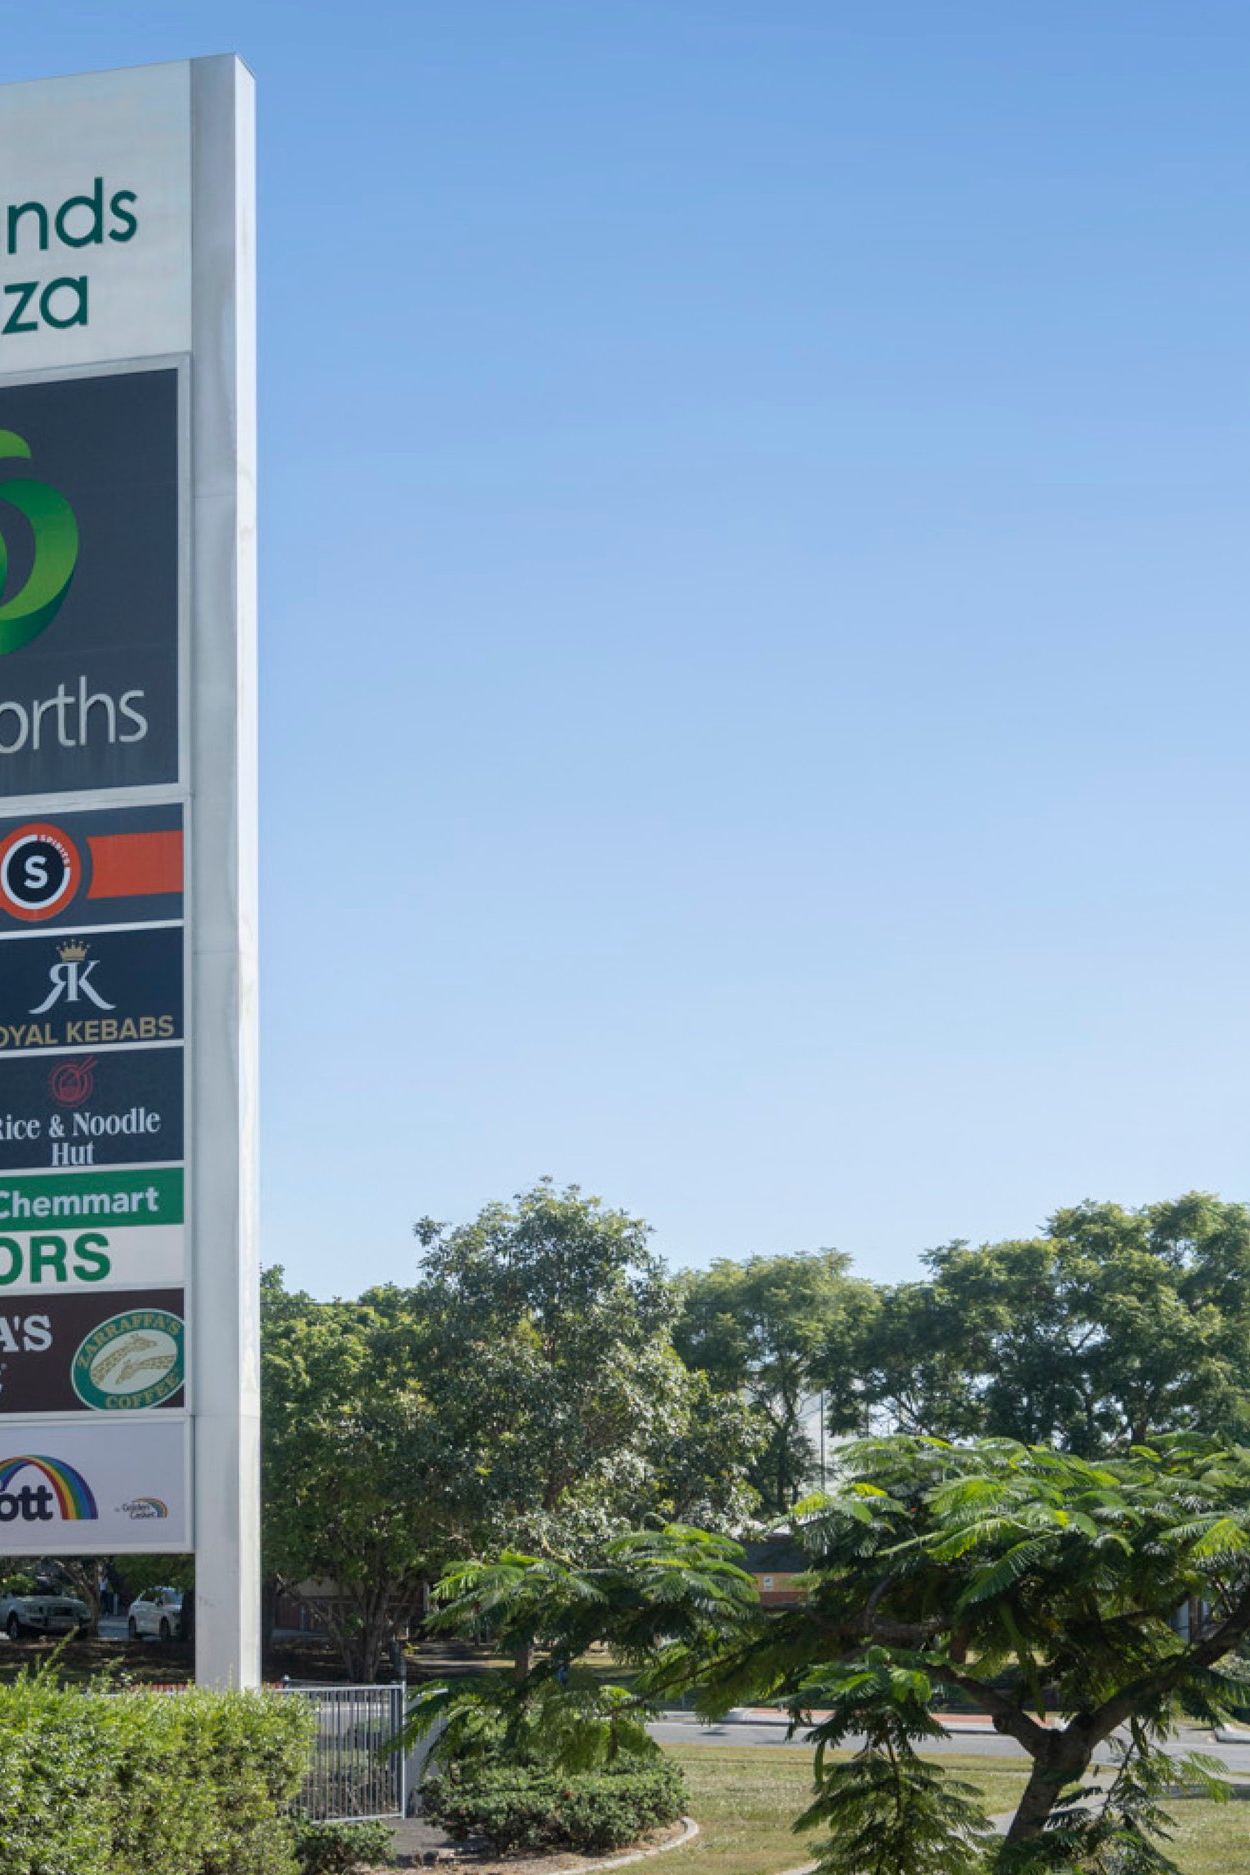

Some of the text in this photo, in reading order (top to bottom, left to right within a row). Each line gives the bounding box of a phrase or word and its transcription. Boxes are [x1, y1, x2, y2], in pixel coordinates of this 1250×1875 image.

[66, 1015, 174, 1043] KEBABS
[48, 1113, 65, 1138] &
[72, 1106, 161, 1136] Noodle
[51, 1140, 94, 1167] Hut
